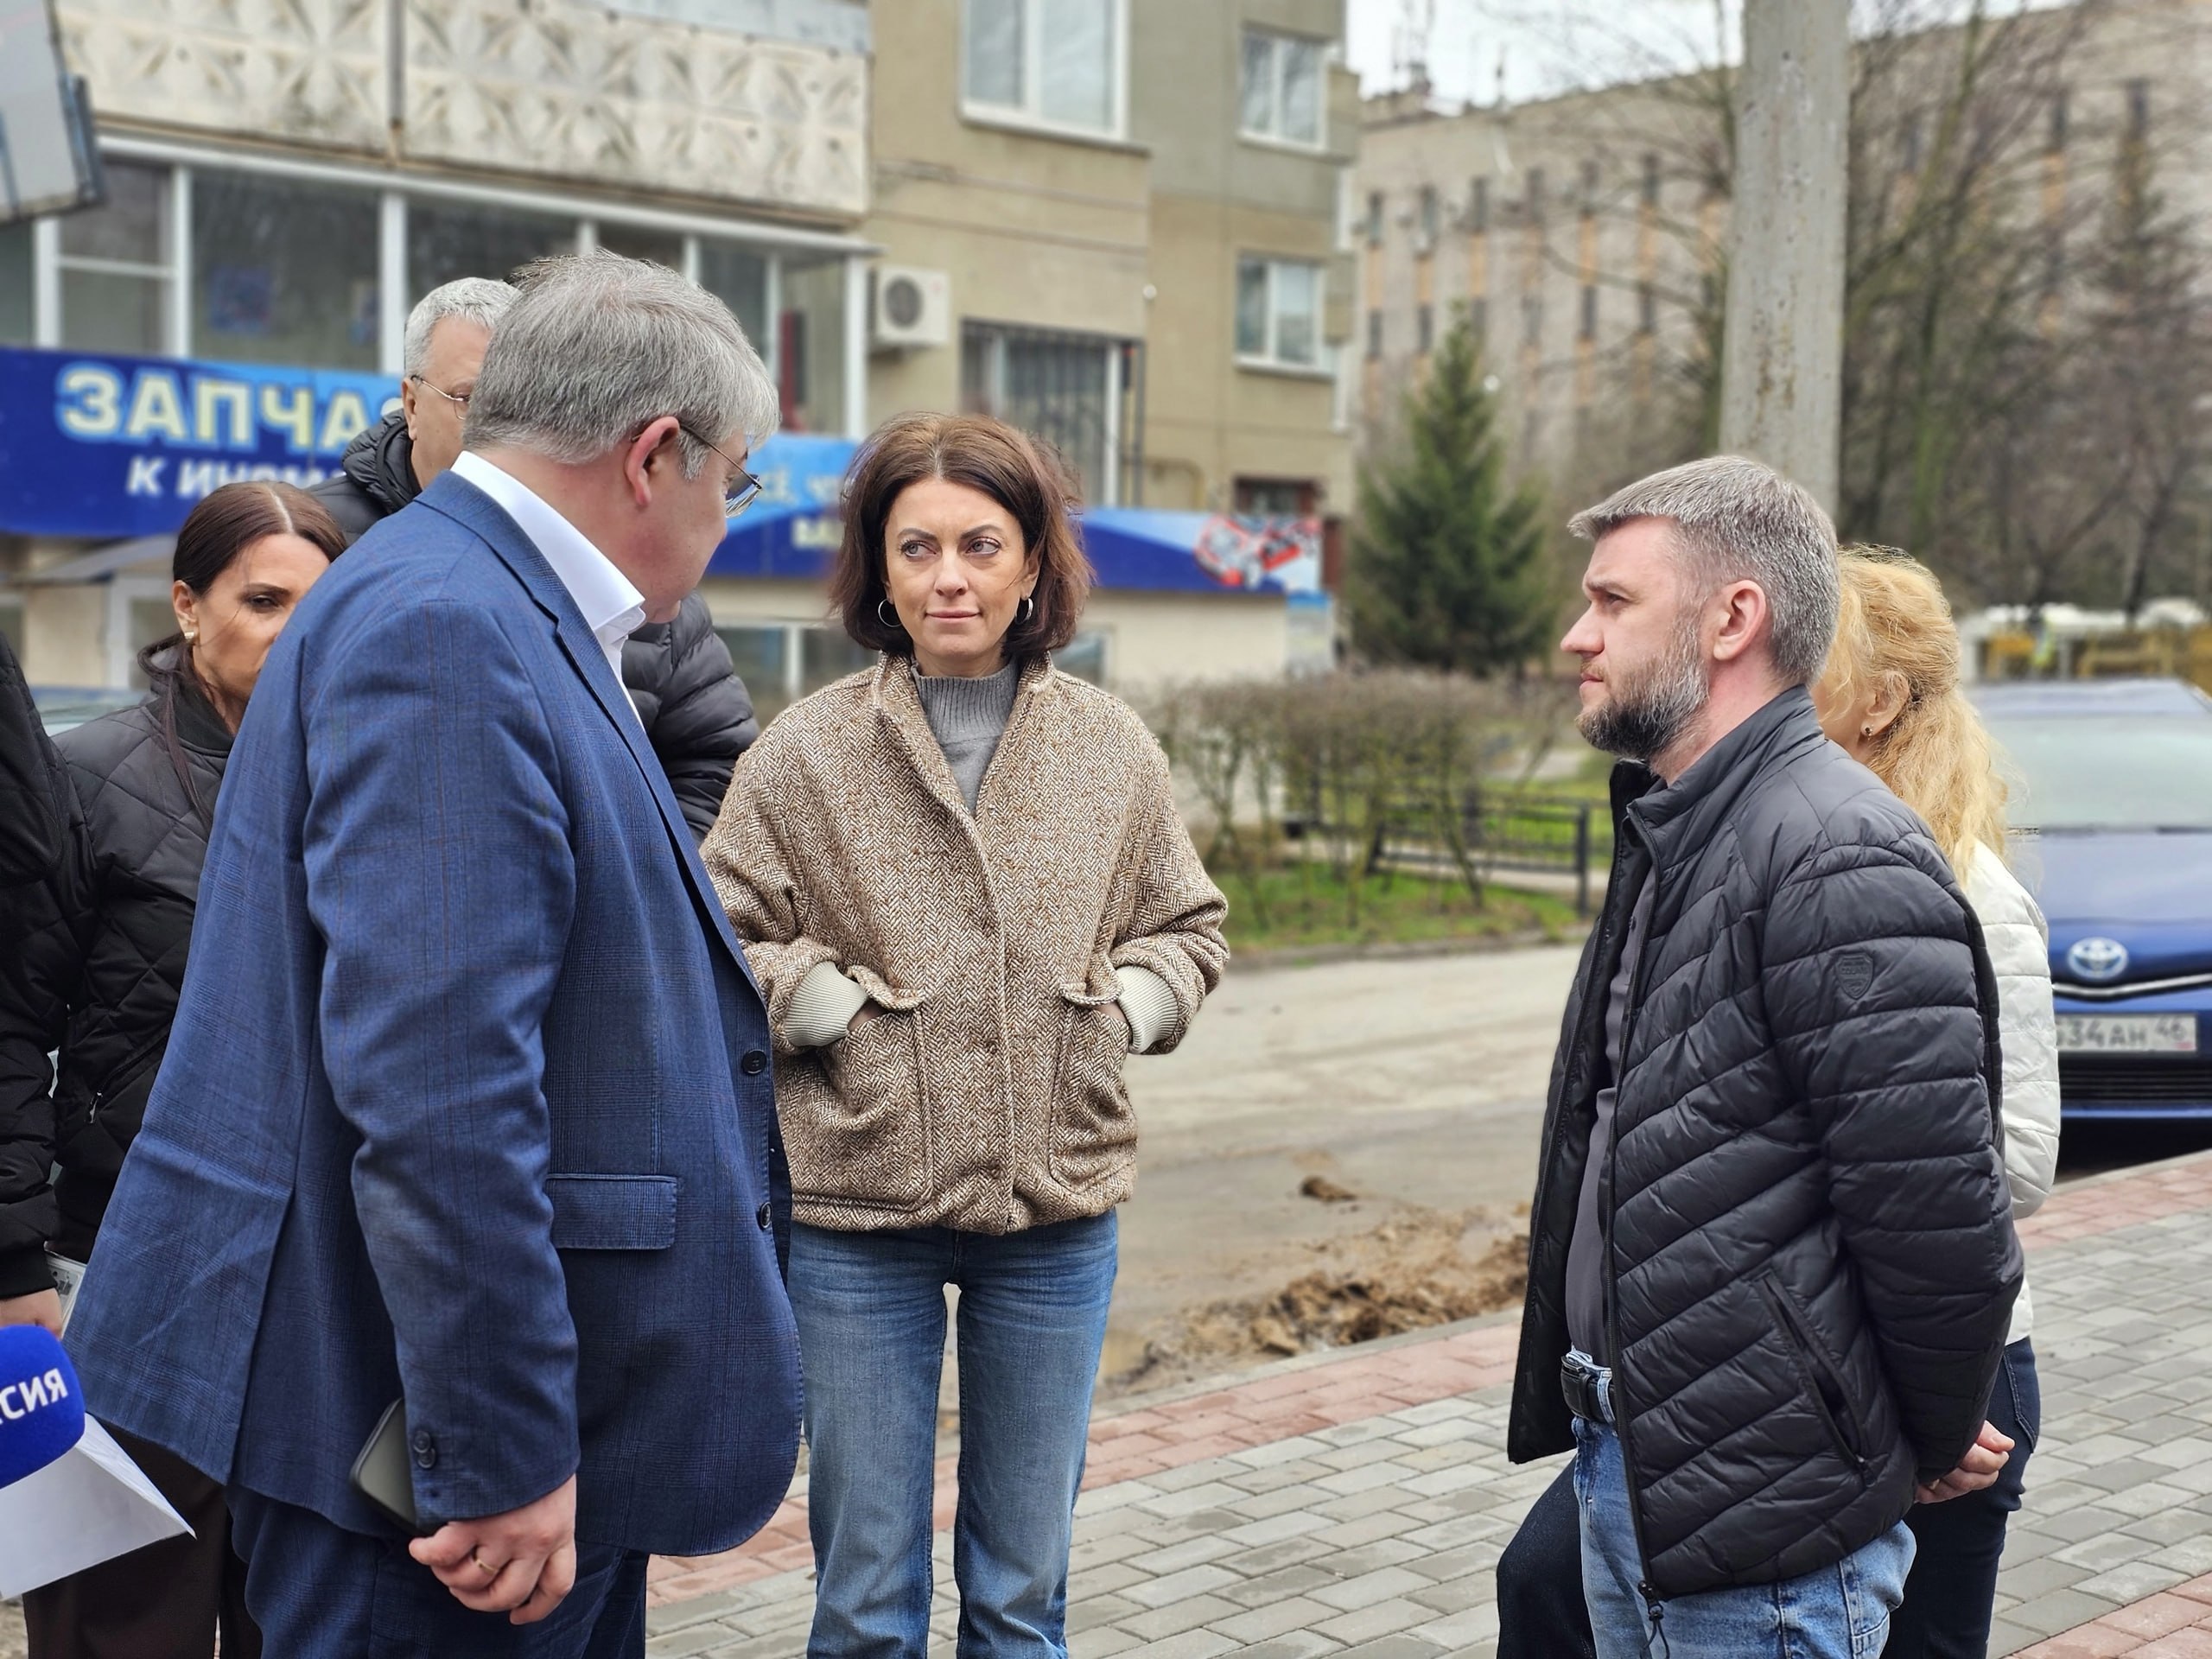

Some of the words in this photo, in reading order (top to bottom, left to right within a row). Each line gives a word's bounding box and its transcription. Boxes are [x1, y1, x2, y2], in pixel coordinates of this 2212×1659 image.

[62, 365, 404, 450] ЗАПЧА
[127, 457, 167, 496] К
[0, 1368, 68, 1425] СИЯ
